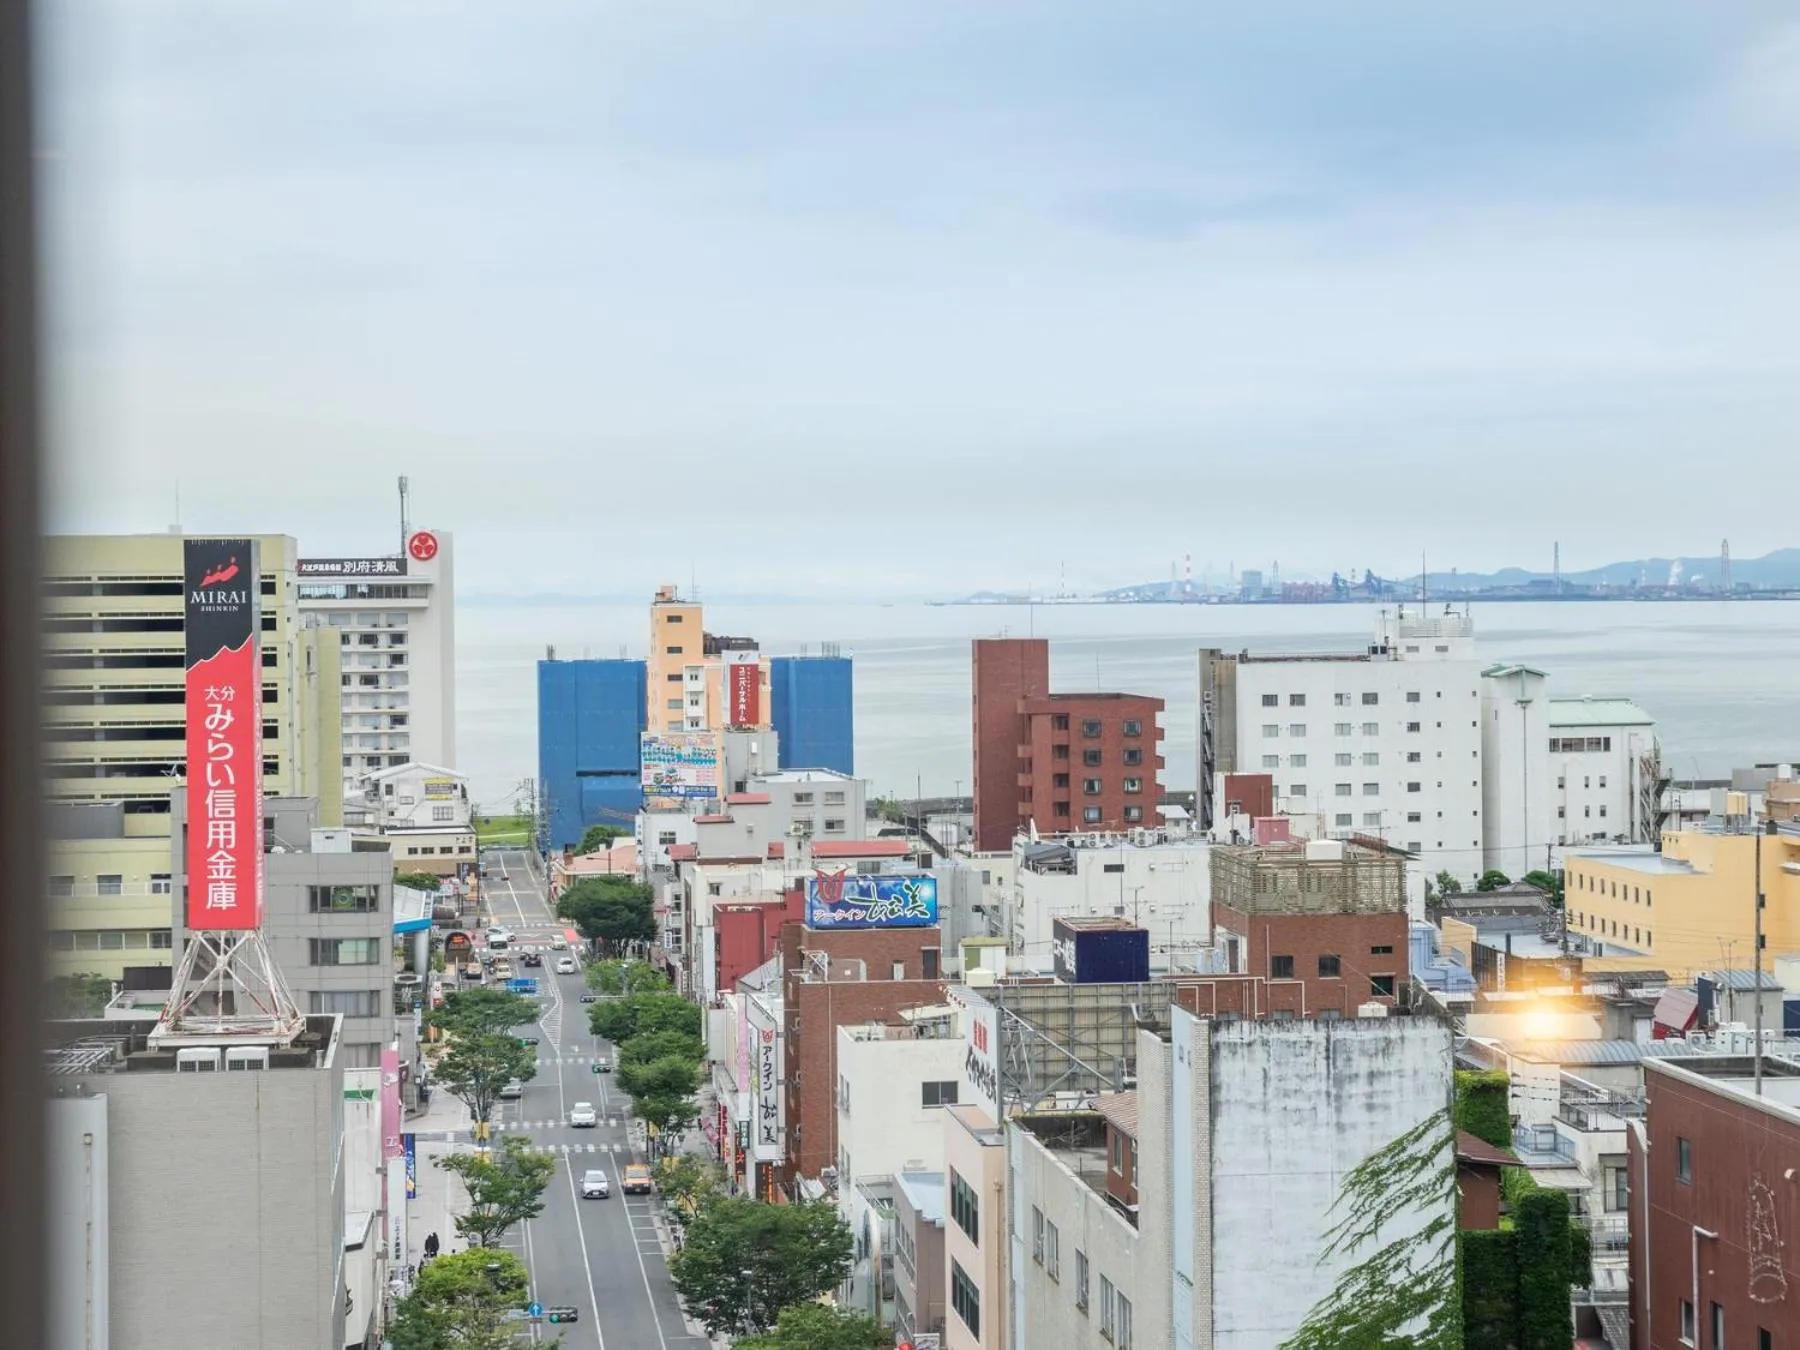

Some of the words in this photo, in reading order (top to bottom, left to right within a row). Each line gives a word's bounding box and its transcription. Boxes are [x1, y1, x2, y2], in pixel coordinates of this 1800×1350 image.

[342, 560, 399, 574] 別府清風
[190, 591, 247, 604] MIRAI
[204, 685, 236, 701] 大分
[738, 666, 747, 722] ユニバーサルホーム
[204, 703, 237, 911] みらい信用金庫
[814, 909, 866, 922] アークイン
[762, 1046, 773, 1091] アークイン
